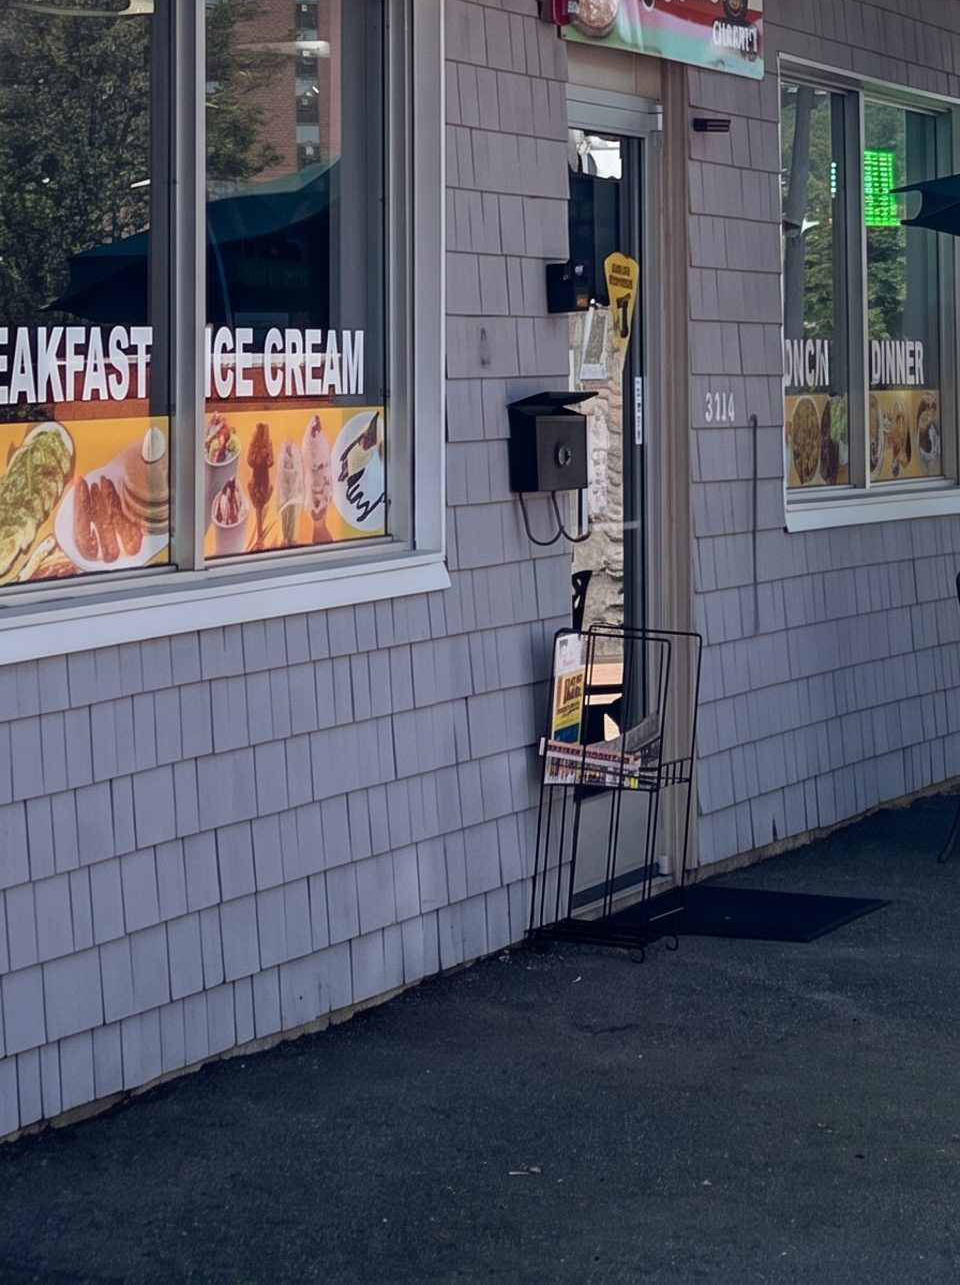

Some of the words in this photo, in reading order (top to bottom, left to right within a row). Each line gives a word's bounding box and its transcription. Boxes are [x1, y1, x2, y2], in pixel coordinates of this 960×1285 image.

[205, 326, 254, 399] ICE
[264, 328, 365, 397] CREAM
[871, 340, 925, 385] DINNER
